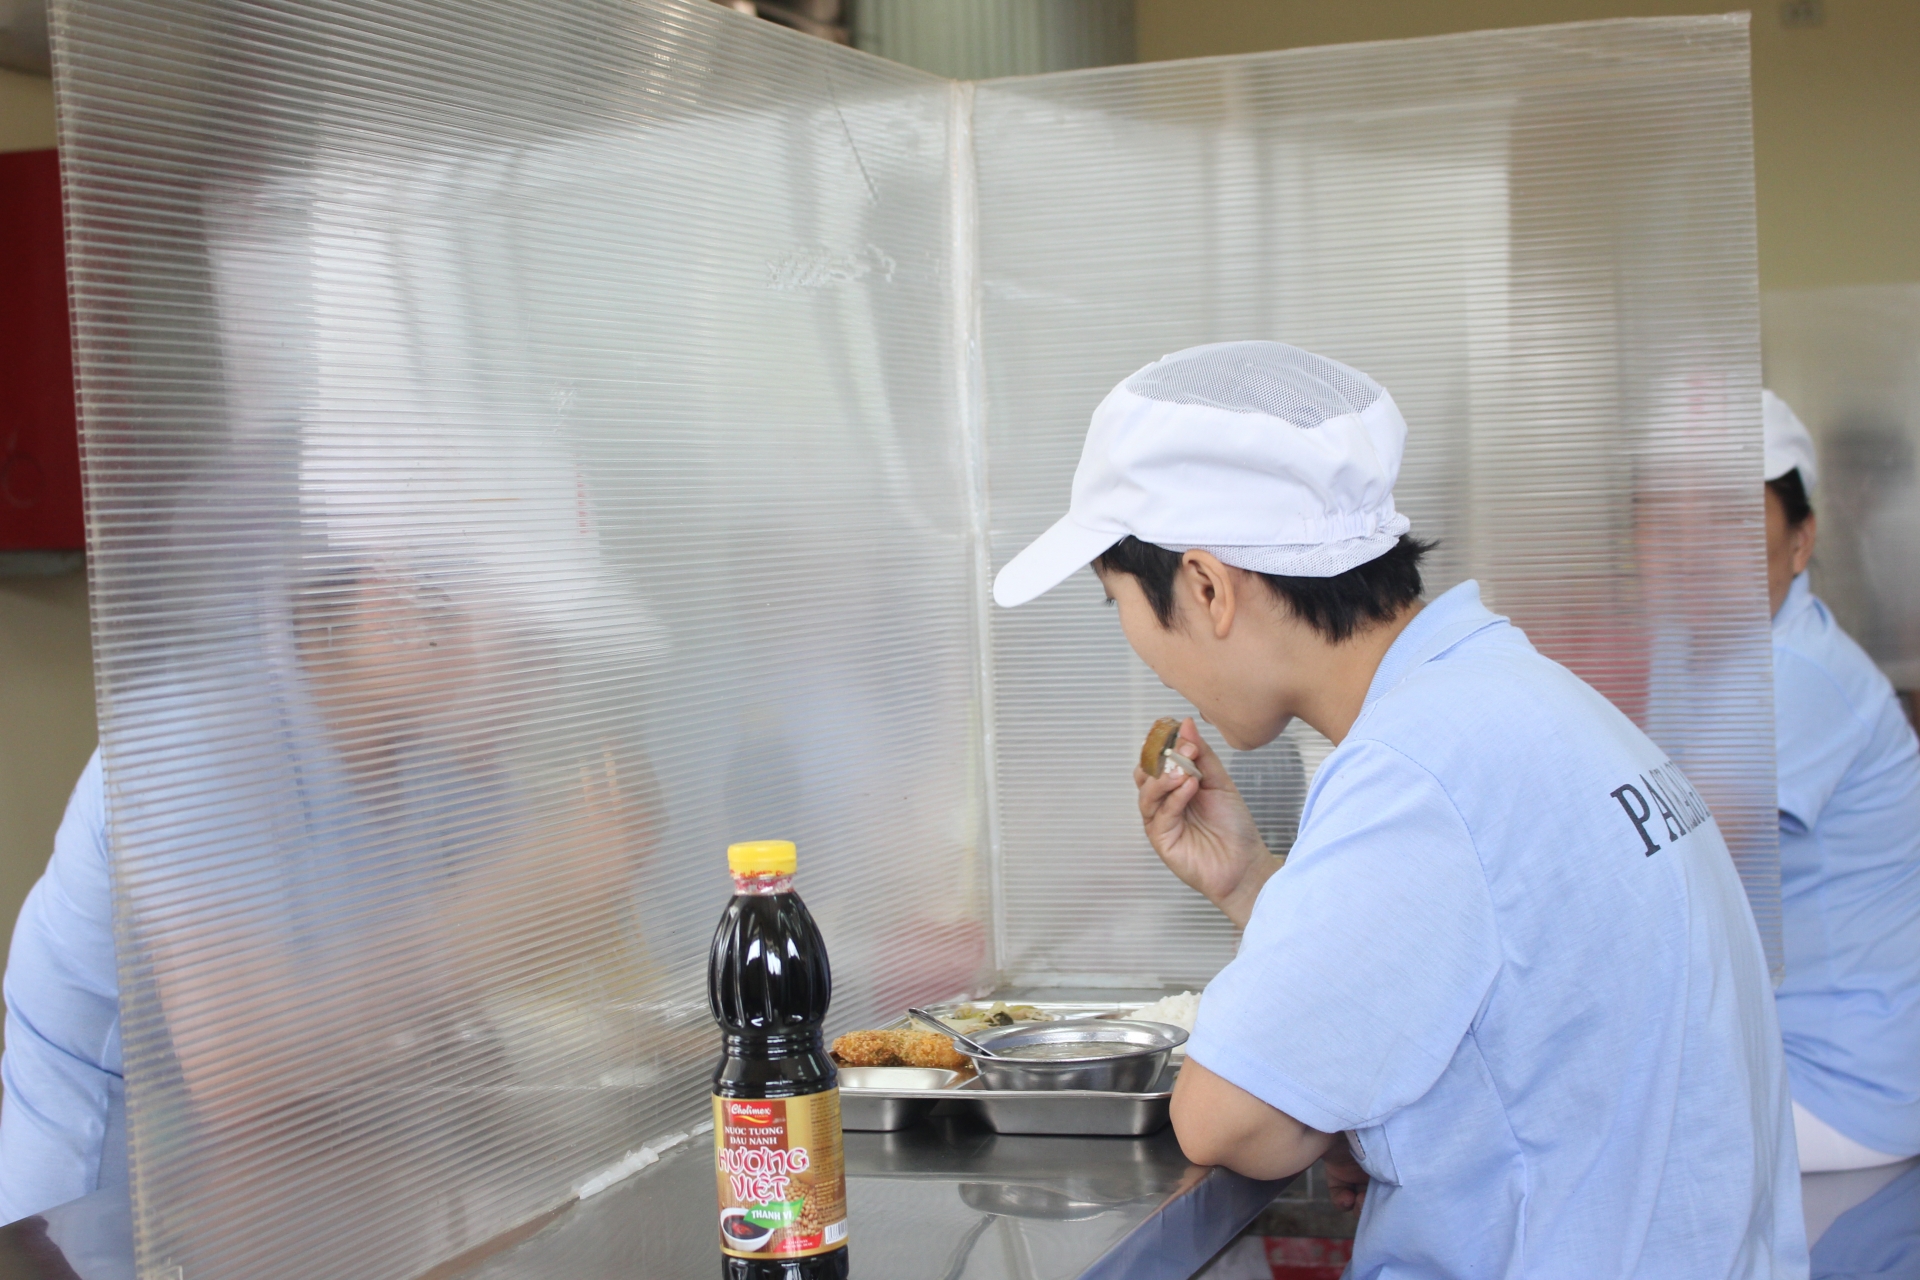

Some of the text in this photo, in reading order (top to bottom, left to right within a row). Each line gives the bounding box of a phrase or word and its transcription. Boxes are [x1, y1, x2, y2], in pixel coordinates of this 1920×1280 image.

[731, 1103, 771, 1116] Cholimex
[730, 1171, 790, 1206] VIỆT
[751, 1209, 781, 1221] THANH
